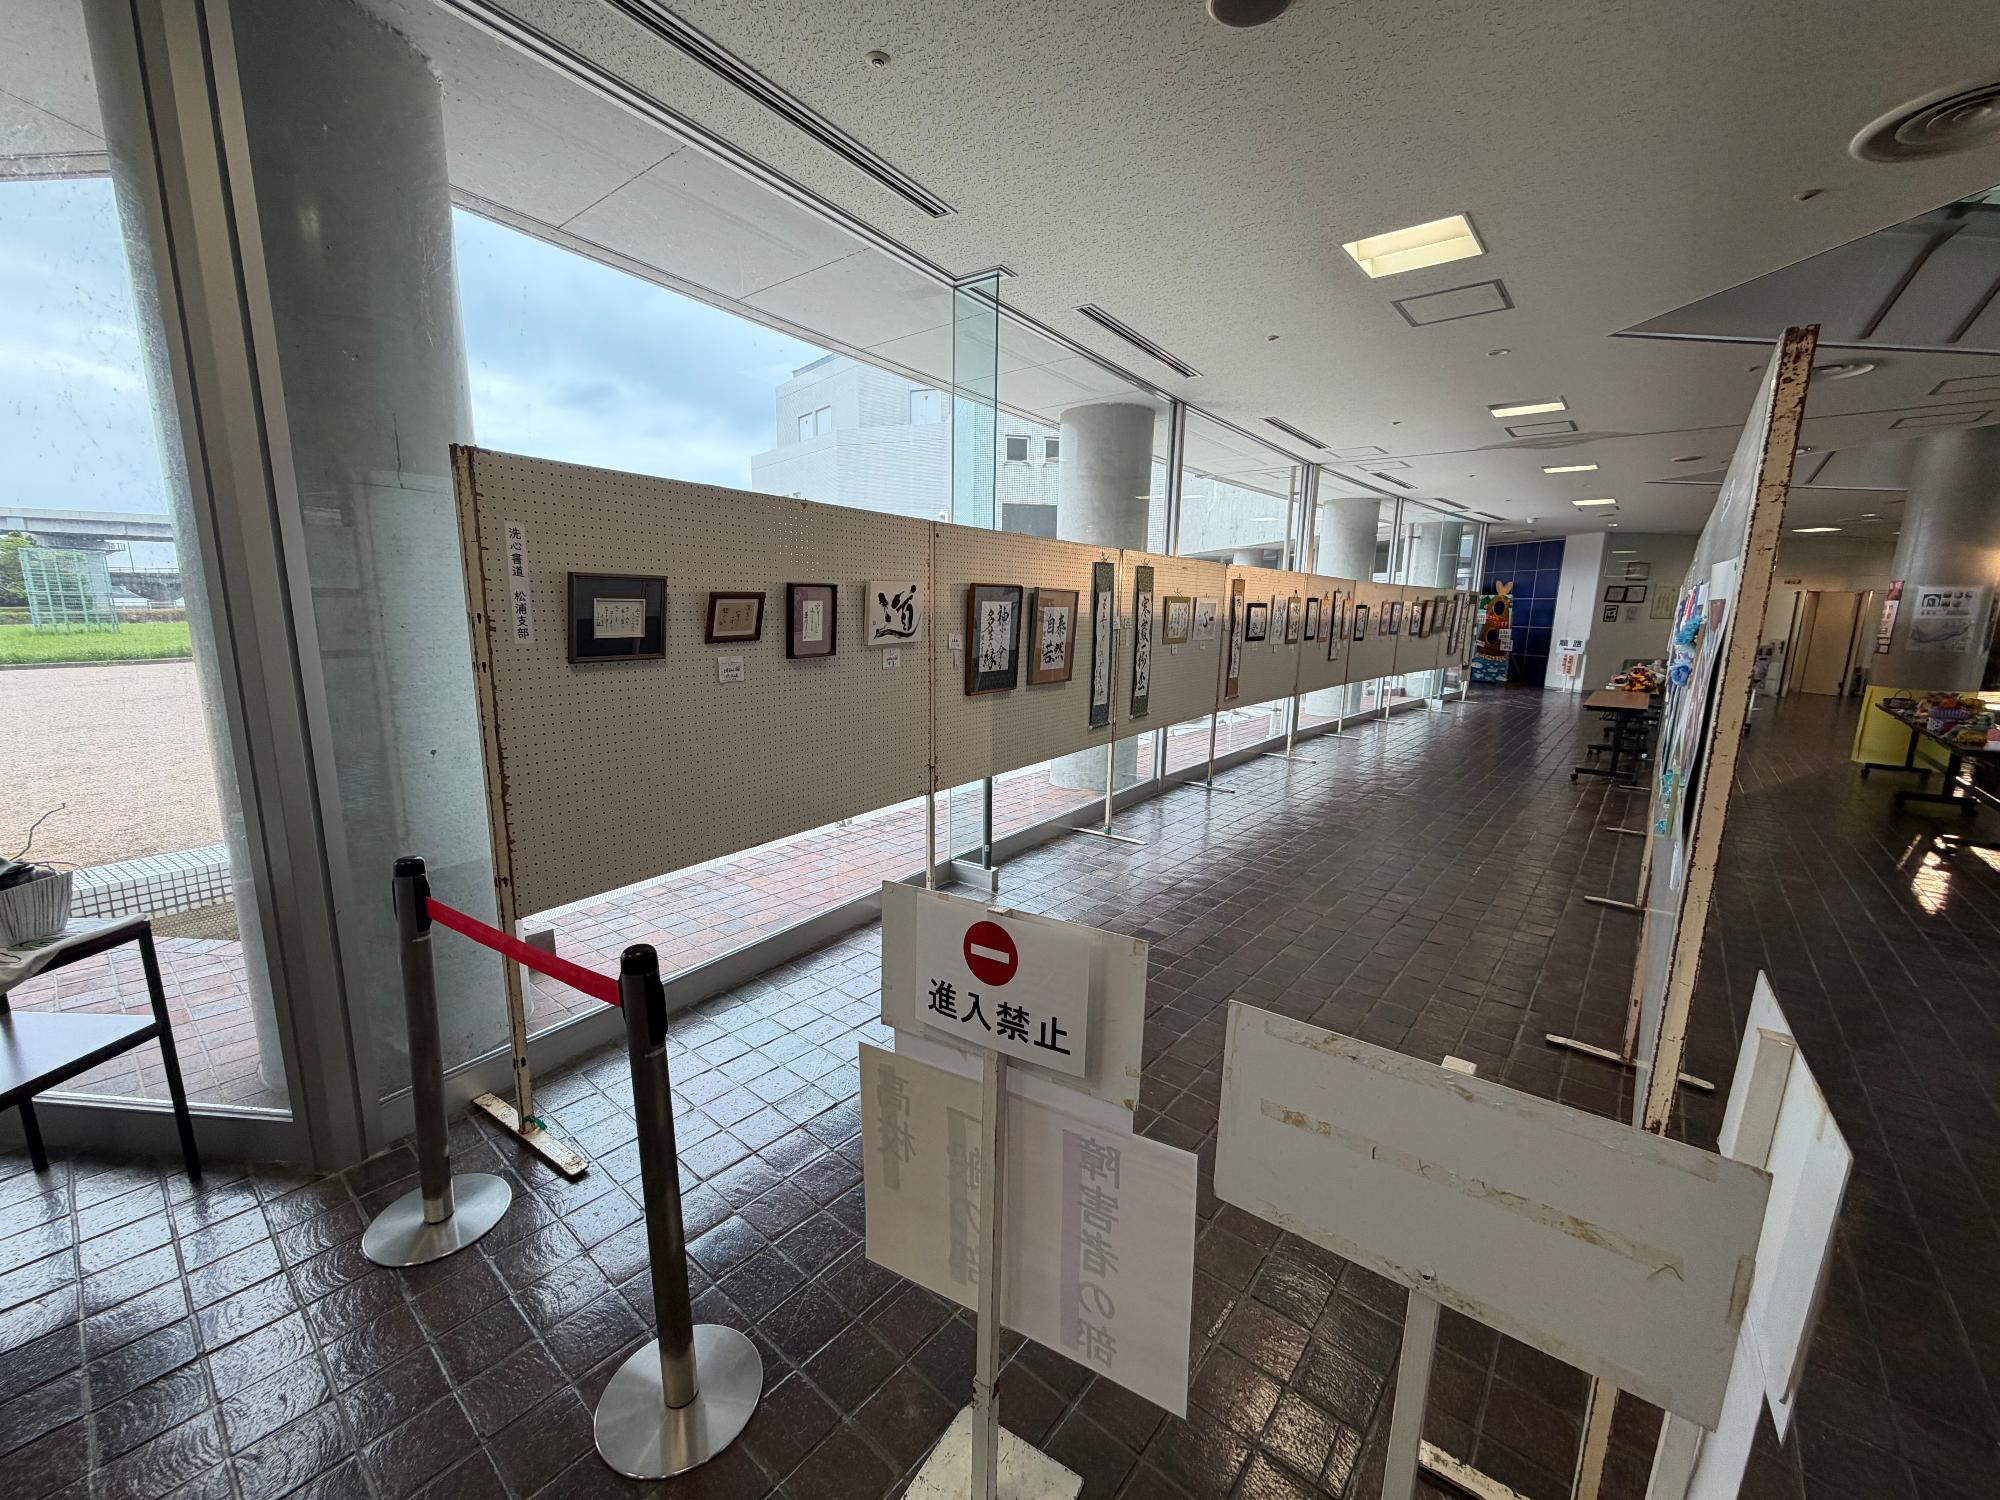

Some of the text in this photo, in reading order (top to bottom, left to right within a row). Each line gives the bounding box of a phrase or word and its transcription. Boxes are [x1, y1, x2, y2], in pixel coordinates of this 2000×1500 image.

[508, 527, 530, 640] 洗心書道 松浦支部
[874, 584, 923, 639] 道
[927, 978, 1071, 1056] 進入禁止
